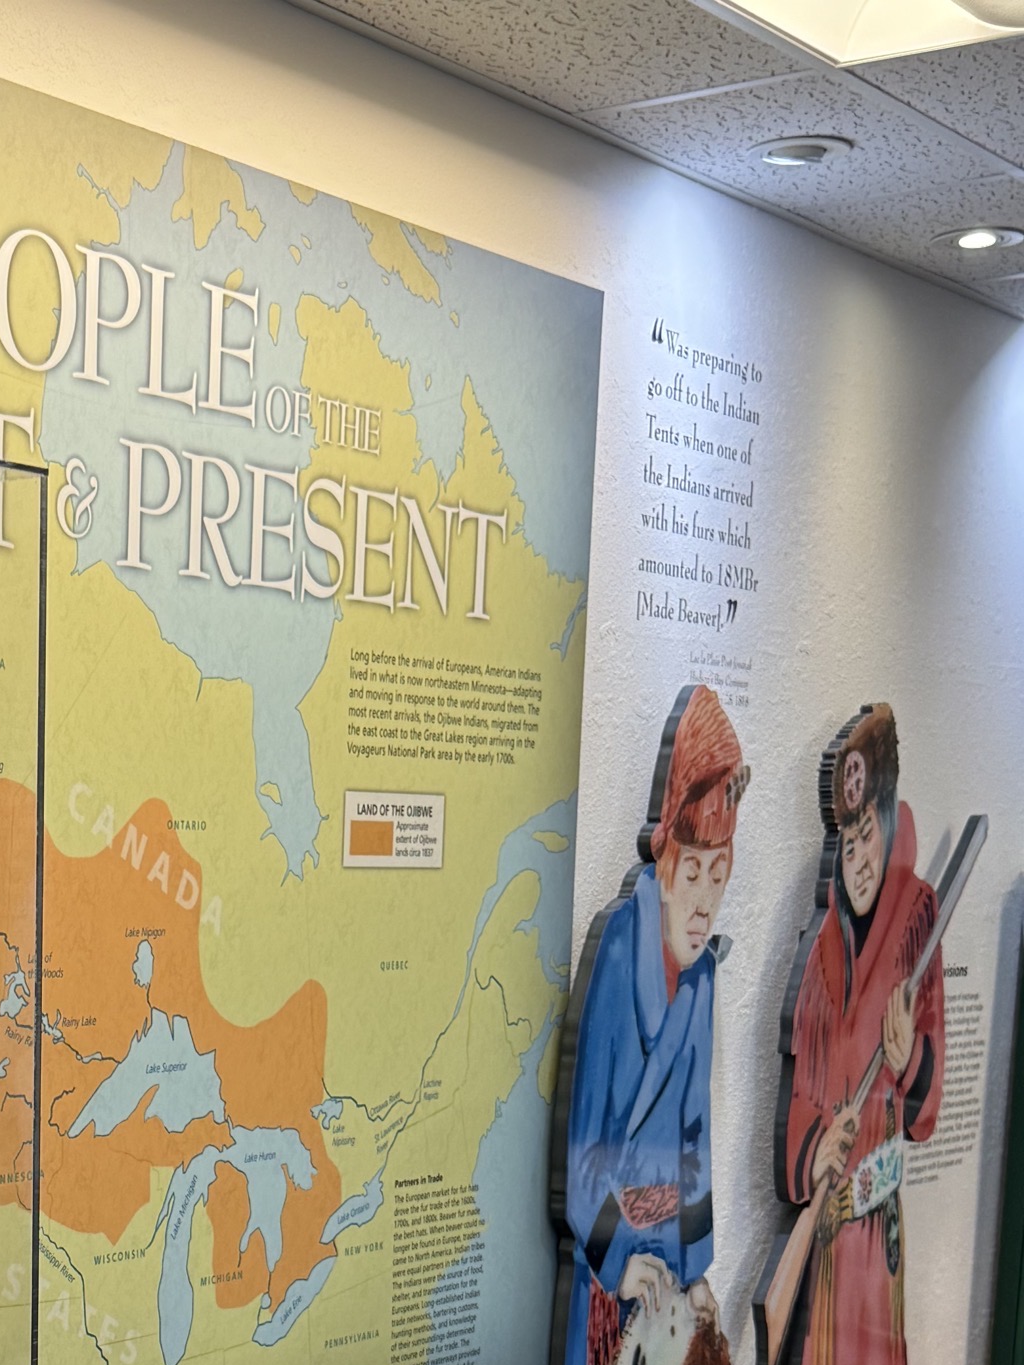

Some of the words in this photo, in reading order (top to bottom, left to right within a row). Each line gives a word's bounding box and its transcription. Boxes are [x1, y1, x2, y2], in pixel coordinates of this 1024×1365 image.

[647, 376, 663, 401] go
[665, 373, 683, 403] off
[686, 386, 698, 407] to
[701, 386, 720, 414] the
[723, 391, 760, 426] Indian
[264, 383, 313, 436] OF
[317, 399, 382, 455] THE
[646, 412, 680, 447] Tents
[683, 423, 714, 456] when
[716, 444, 738, 462] one
[740, 438, 753, 466] of
[643, 457, 663, 487] the
[665, 463, 711, 498] Indians
[713, 480, 754, 508] arrived
[55, 458, 100, 540] &
[118, 437, 508, 620] PRESENT
[641, 503, 668, 532] with
[671, 505, 689, 537] his
[692, 510, 715, 542] furs
[717, 517, 751, 550] which
[638, 553, 699, 582] amounted
[701, 564, 713, 584] to
[717, 563, 759, 593] 18MBr
[350, 647, 370, 666] Long
[371, 650, 397, 666] before
[397, 653, 411, 668] the
[411, 656, 435, 670] arrival
[435, 658, 445, 671] of
[445, 658, 483, 677] Europeans,
[484, 664, 517, 679] American
[518, 668, 542, 682] Indians
[357, 803, 378, 816] LAND
[379, 804, 390, 816] OF
[391, 805, 405, 816] THE
[406, 805, 433, 818] OJIBWE
[167, 820, 207, 831] ONTARIO
[67, 782, 223, 936] CANADA
[125, 927, 140, 938] Lake
[141, 926, 166, 939] Nipigon
[61, 1017, 80, 1029] Rainy
[81, 1016, 97, 1027] Lake
[145, 1063, 162, 1075] Lake
[163, 1061, 187, 1074] Superior
[394, 1177, 419, 1188] Partners
[419, 1176, 427, 1185] in
[428, 1173, 444, 1185] Trade
[94, 1249, 146, 1265] WISCONSIN
[345, 1245, 362, 1256] NEW
[364, 1242, 384, 1253] YORK
[200, 1270, 244, 1287] MICHIGAN
[324, 1329, 380, 1349] PENNSYLVANIA
